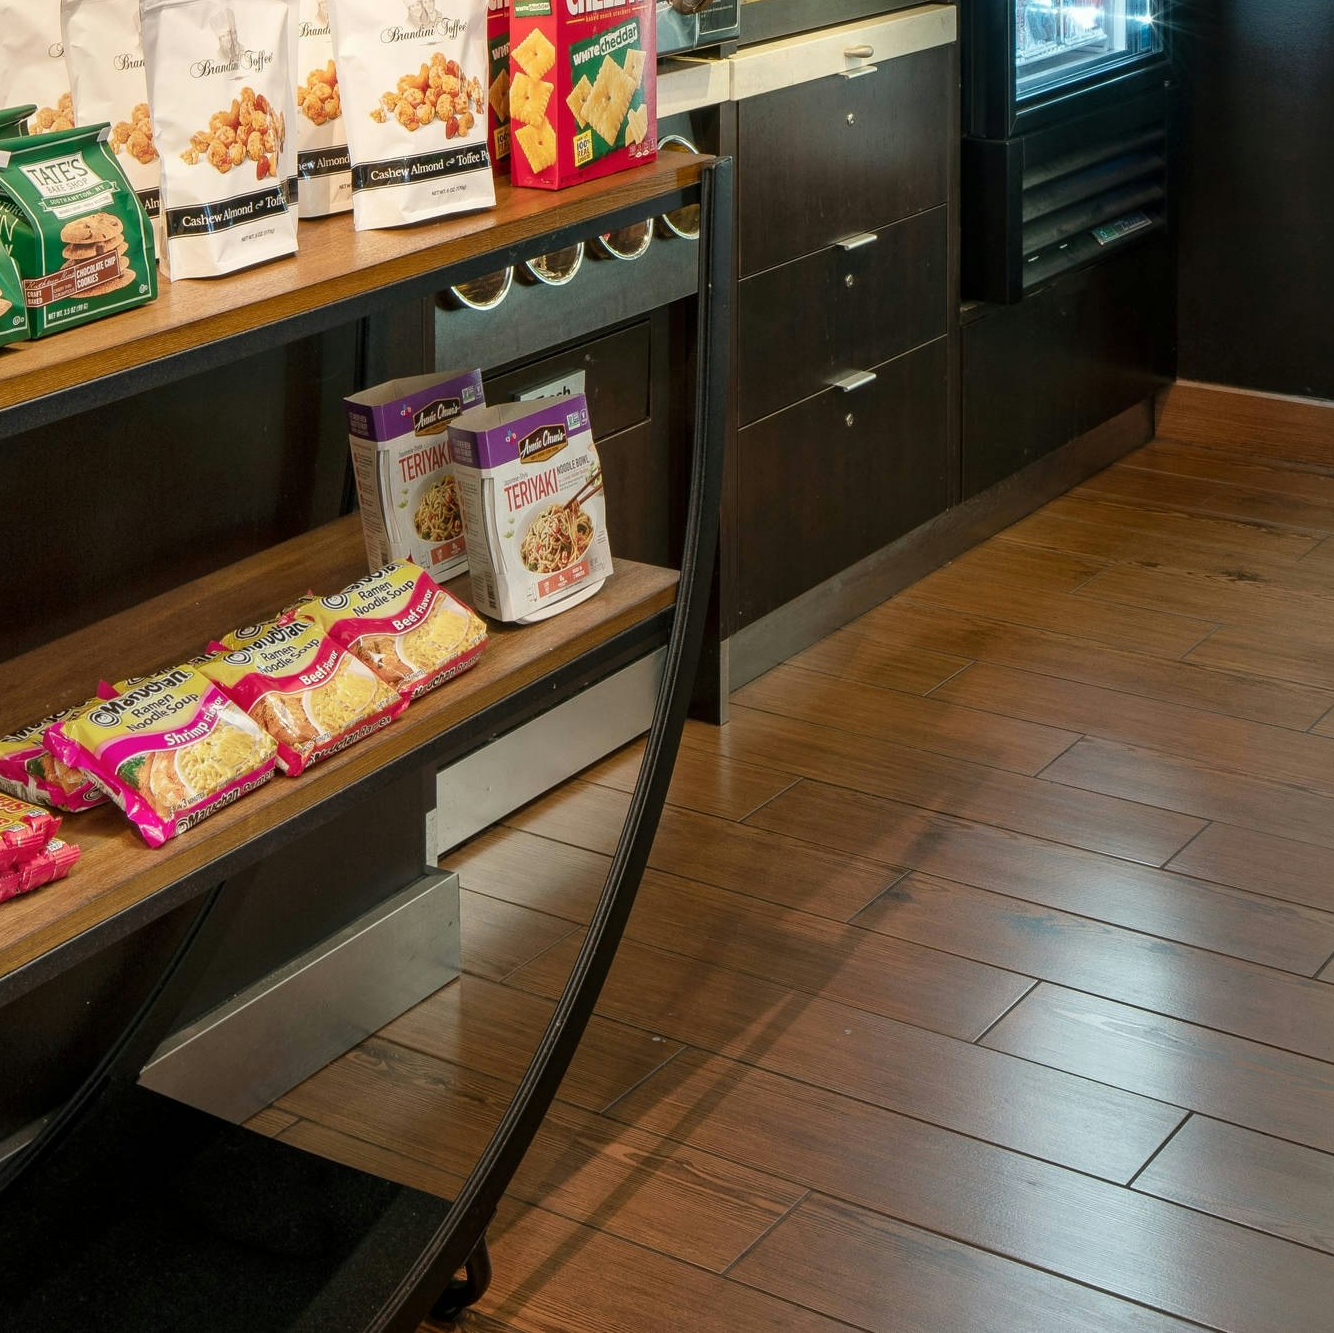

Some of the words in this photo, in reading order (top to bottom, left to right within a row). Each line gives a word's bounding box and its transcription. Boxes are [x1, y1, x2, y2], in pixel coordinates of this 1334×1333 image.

[613, 7, 632, 16] crackers
[380, 24, 435, 44] Brandini
[435, 17, 468, 39] Toffee
[599, 23, 637, 55] cheddar
[240, 49, 274, 74] Toffee
[30, 159, 88, 187] TATE'S
[371, 168, 409, 181] Cashew
[411, 159, 444, 176] Almond
[456, 152, 481, 167] Toffee
[45, 184, 65, 195] BAKE
[66, 178, 88, 191] SHOP
[182, 213, 223, 227] Cashew
[223, 202, 253, 221] Almond
[77, 263, 104, 279] CHOCOLATE
[104, 258, 117, 270] CHIP
[77, 275, 98, 290] COOKIES
[27, 290, 42, 300] CRAFT
[399, 441, 451, 483] TERIYAKI
[556, 461, 576, 475] NOODLE
[504, 467, 559, 512] TERIYAKI
[352, 594, 388, 617] Noodle
[387, 579, 415, 600] Soup
[358, 580, 392, 601] Ramen
[392, 610, 419, 631] Beef
[416, 589, 433, 614] Flavor
[258, 657, 294, 676] Noodle
[290, 638, 320, 660] Soup
[260, 644, 296, 662] Ramen
[299, 667, 327, 687] Beef
[324, 650, 339, 675] Flavor
[101, 669, 190, 716] Maruchan
[131, 693, 174, 718] Ramen
[126, 709, 169, 732] Noodle
[168, 692, 200, 714] Soup
[164, 721, 209, 746] Shrimp
[204, 695, 225, 723] Flavor
[188, 787, 240, 826] Maruchan
